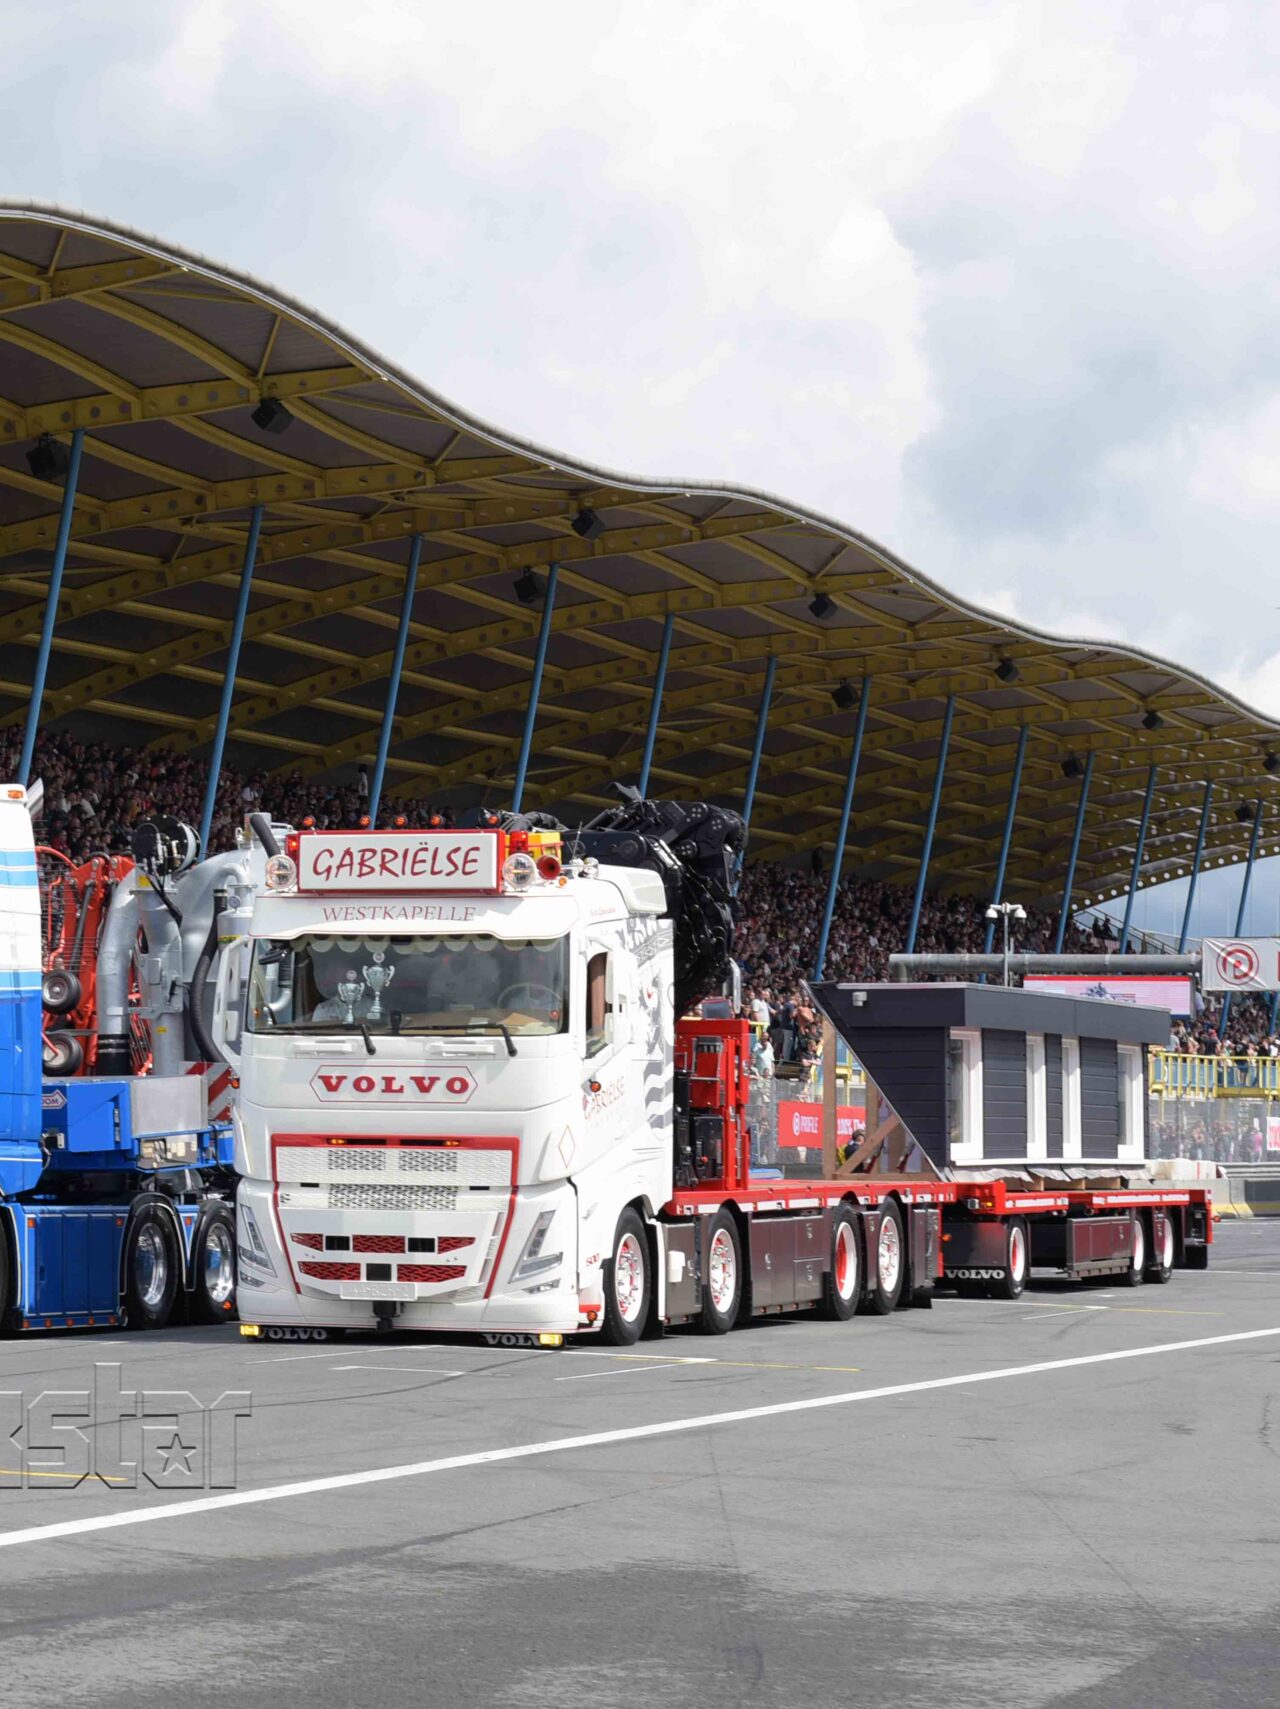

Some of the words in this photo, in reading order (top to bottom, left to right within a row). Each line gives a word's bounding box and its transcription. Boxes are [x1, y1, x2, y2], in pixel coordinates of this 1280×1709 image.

[313, 841, 480, 881] GABRIËLSE
[322, 905, 476, 922] WESTKAPELLE
[318, 1075, 469, 1095] VOLVO
[945, 1269, 1006, 1280] VOLVO
